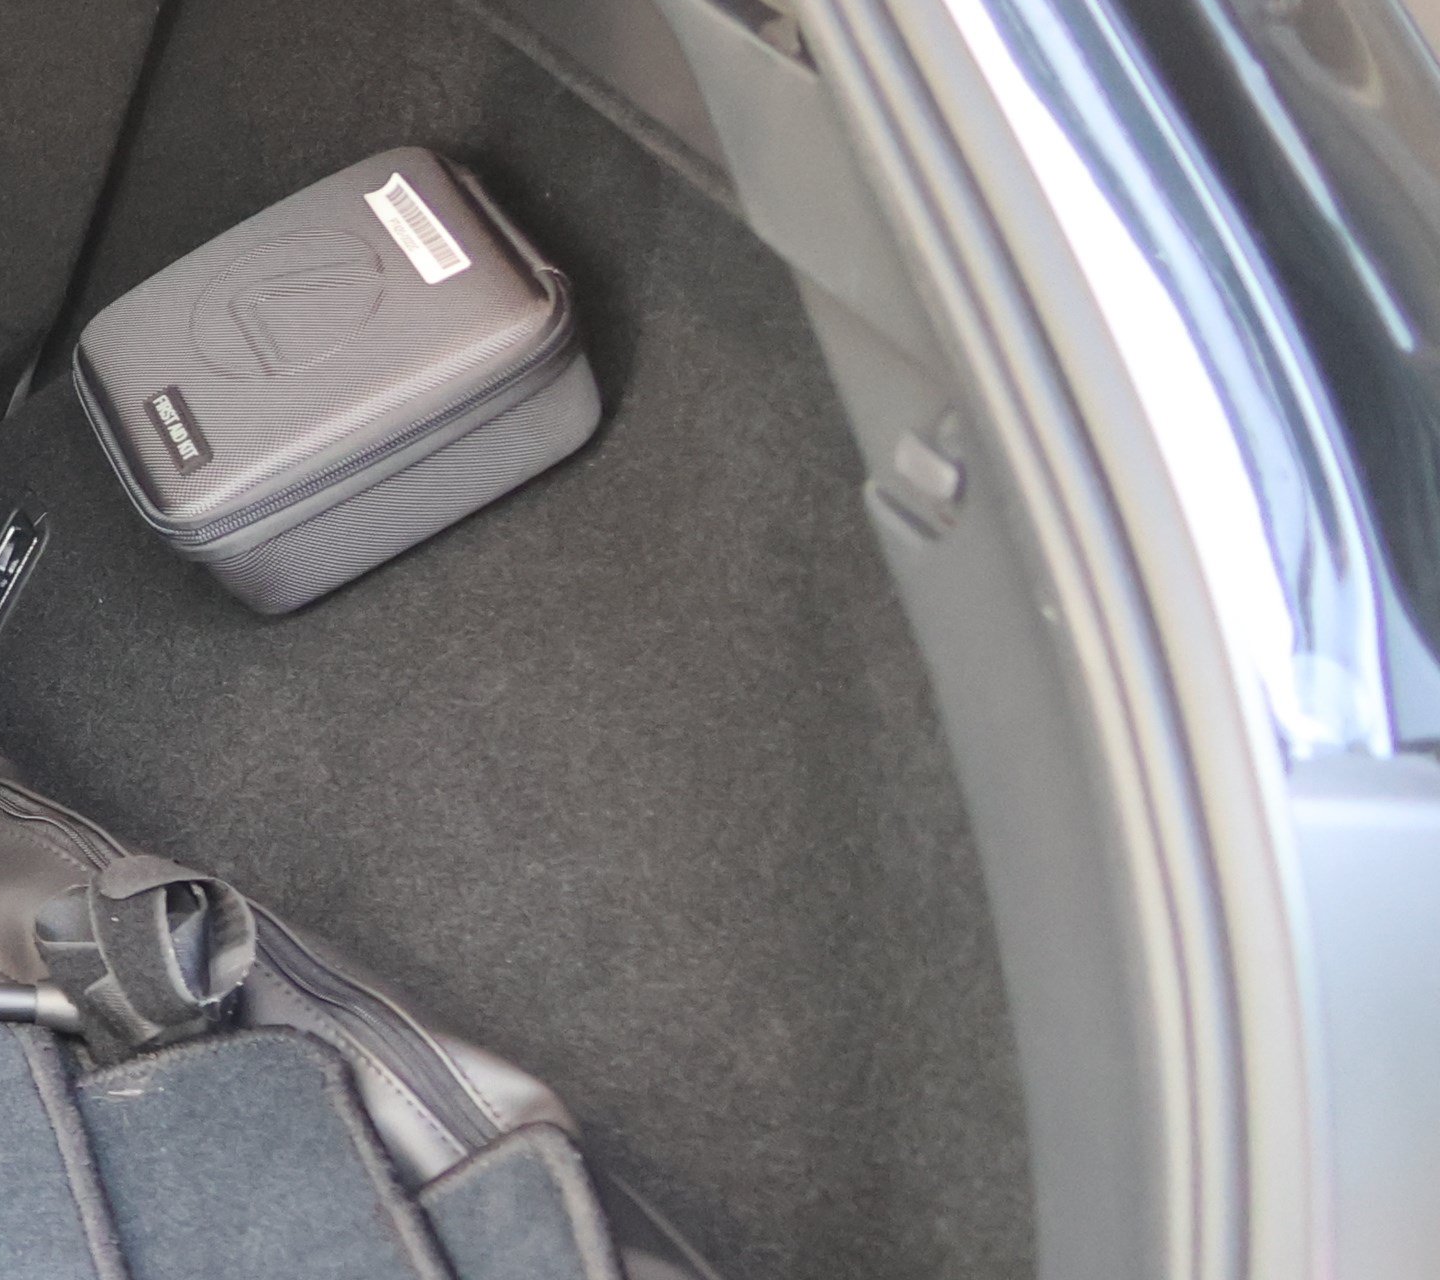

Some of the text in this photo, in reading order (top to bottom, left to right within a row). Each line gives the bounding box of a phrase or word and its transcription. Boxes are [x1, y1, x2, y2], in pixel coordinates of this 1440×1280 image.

[153, 395, 199, 460] FIRST AID KIT
